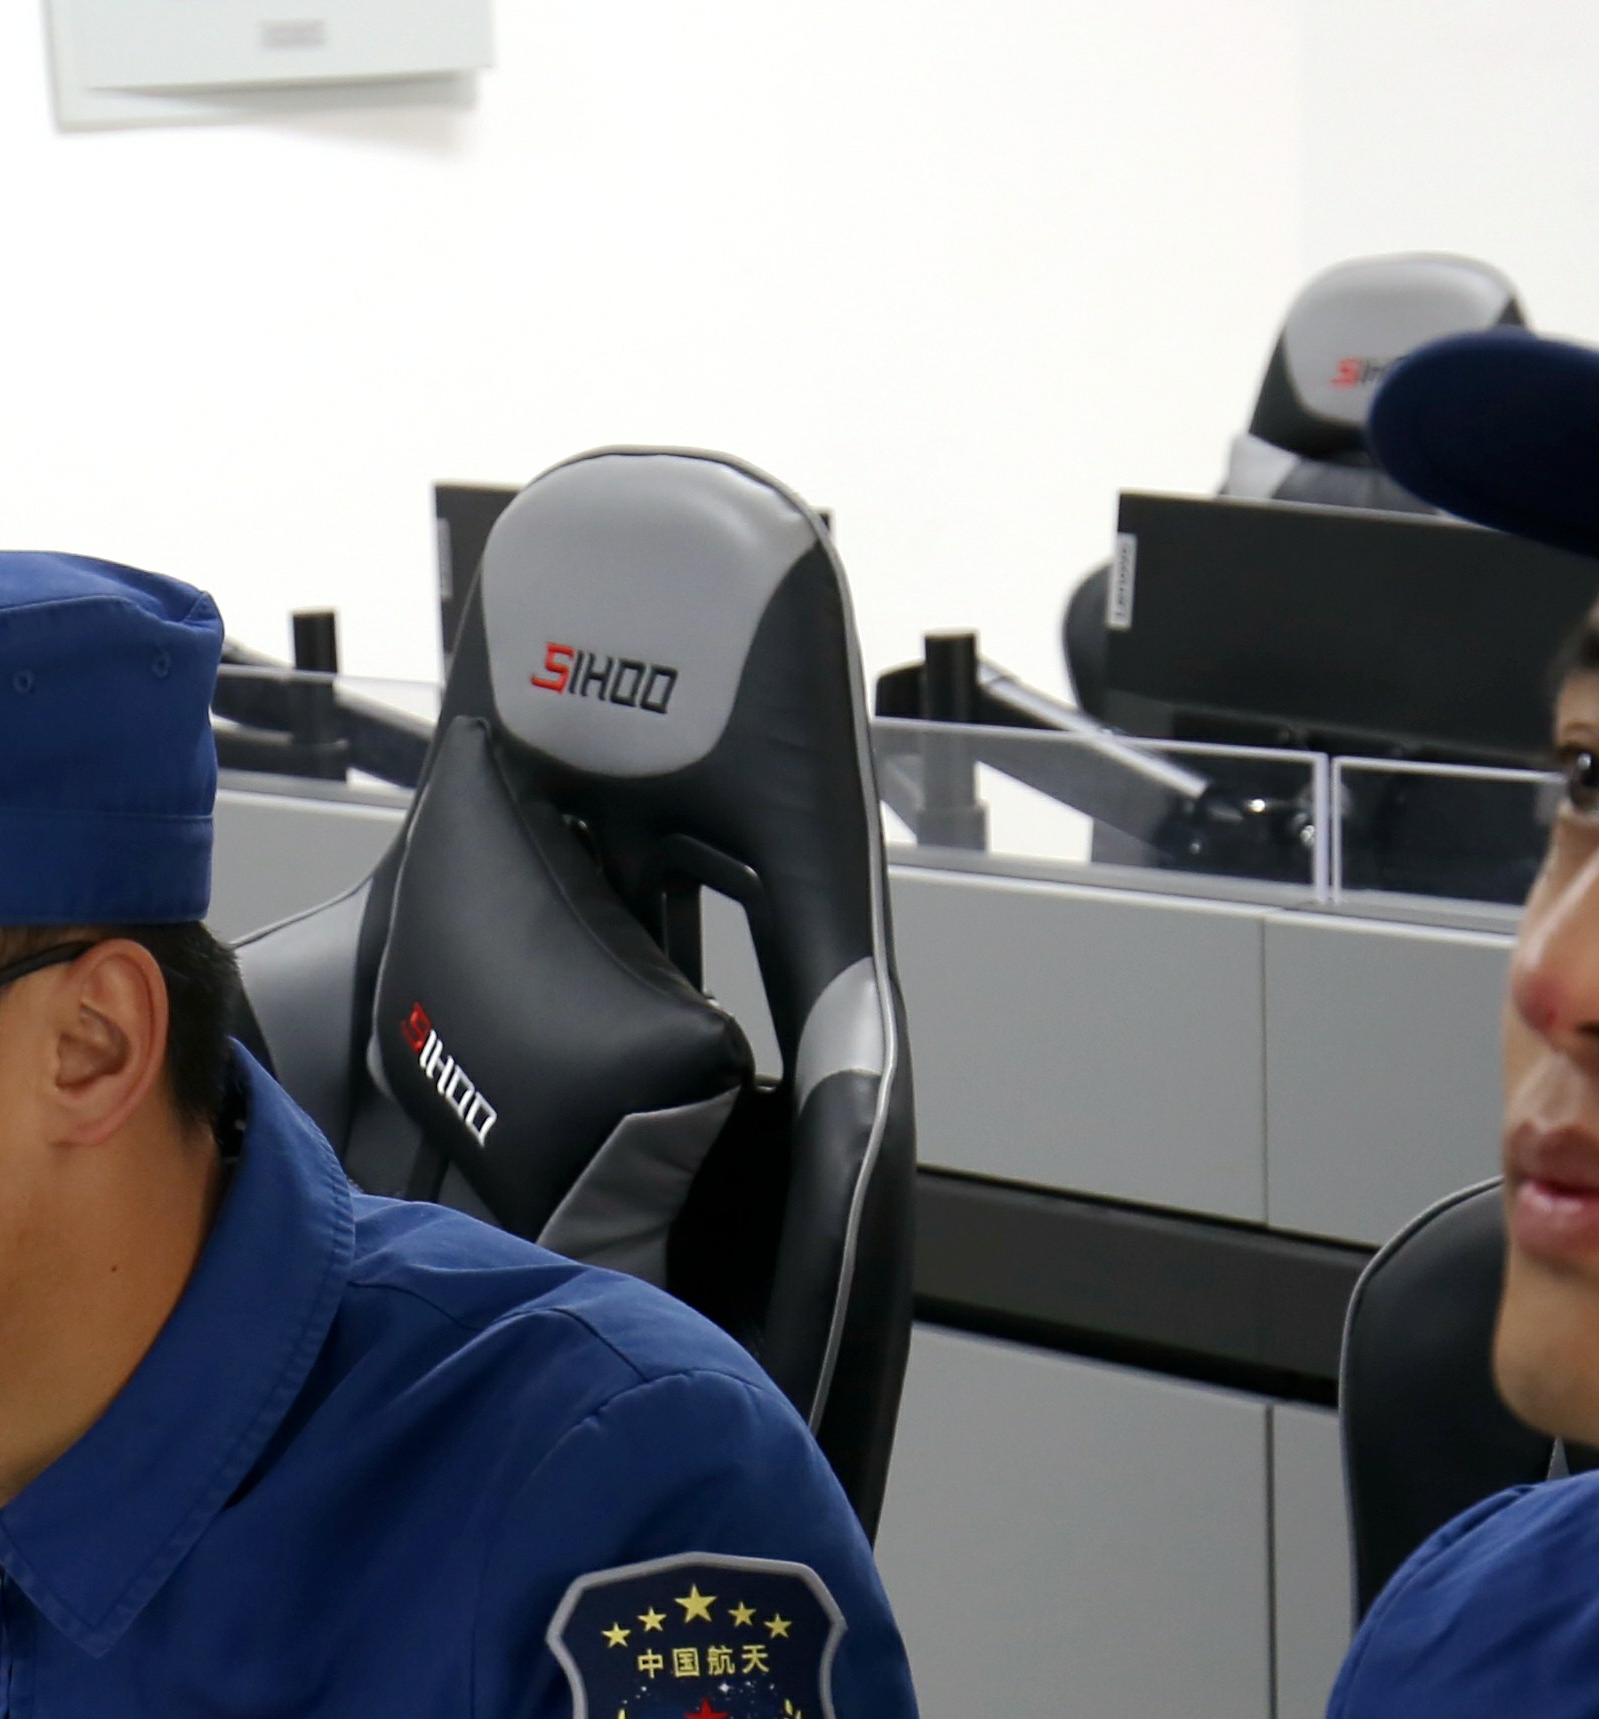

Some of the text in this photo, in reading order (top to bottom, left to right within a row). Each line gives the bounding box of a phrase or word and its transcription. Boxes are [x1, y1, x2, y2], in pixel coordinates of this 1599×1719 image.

[528, 641, 679, 715] SIHOO
[400, 1002, 498, 1148] SIHOO
[637, 1643, 770, 1679] 中国航天
